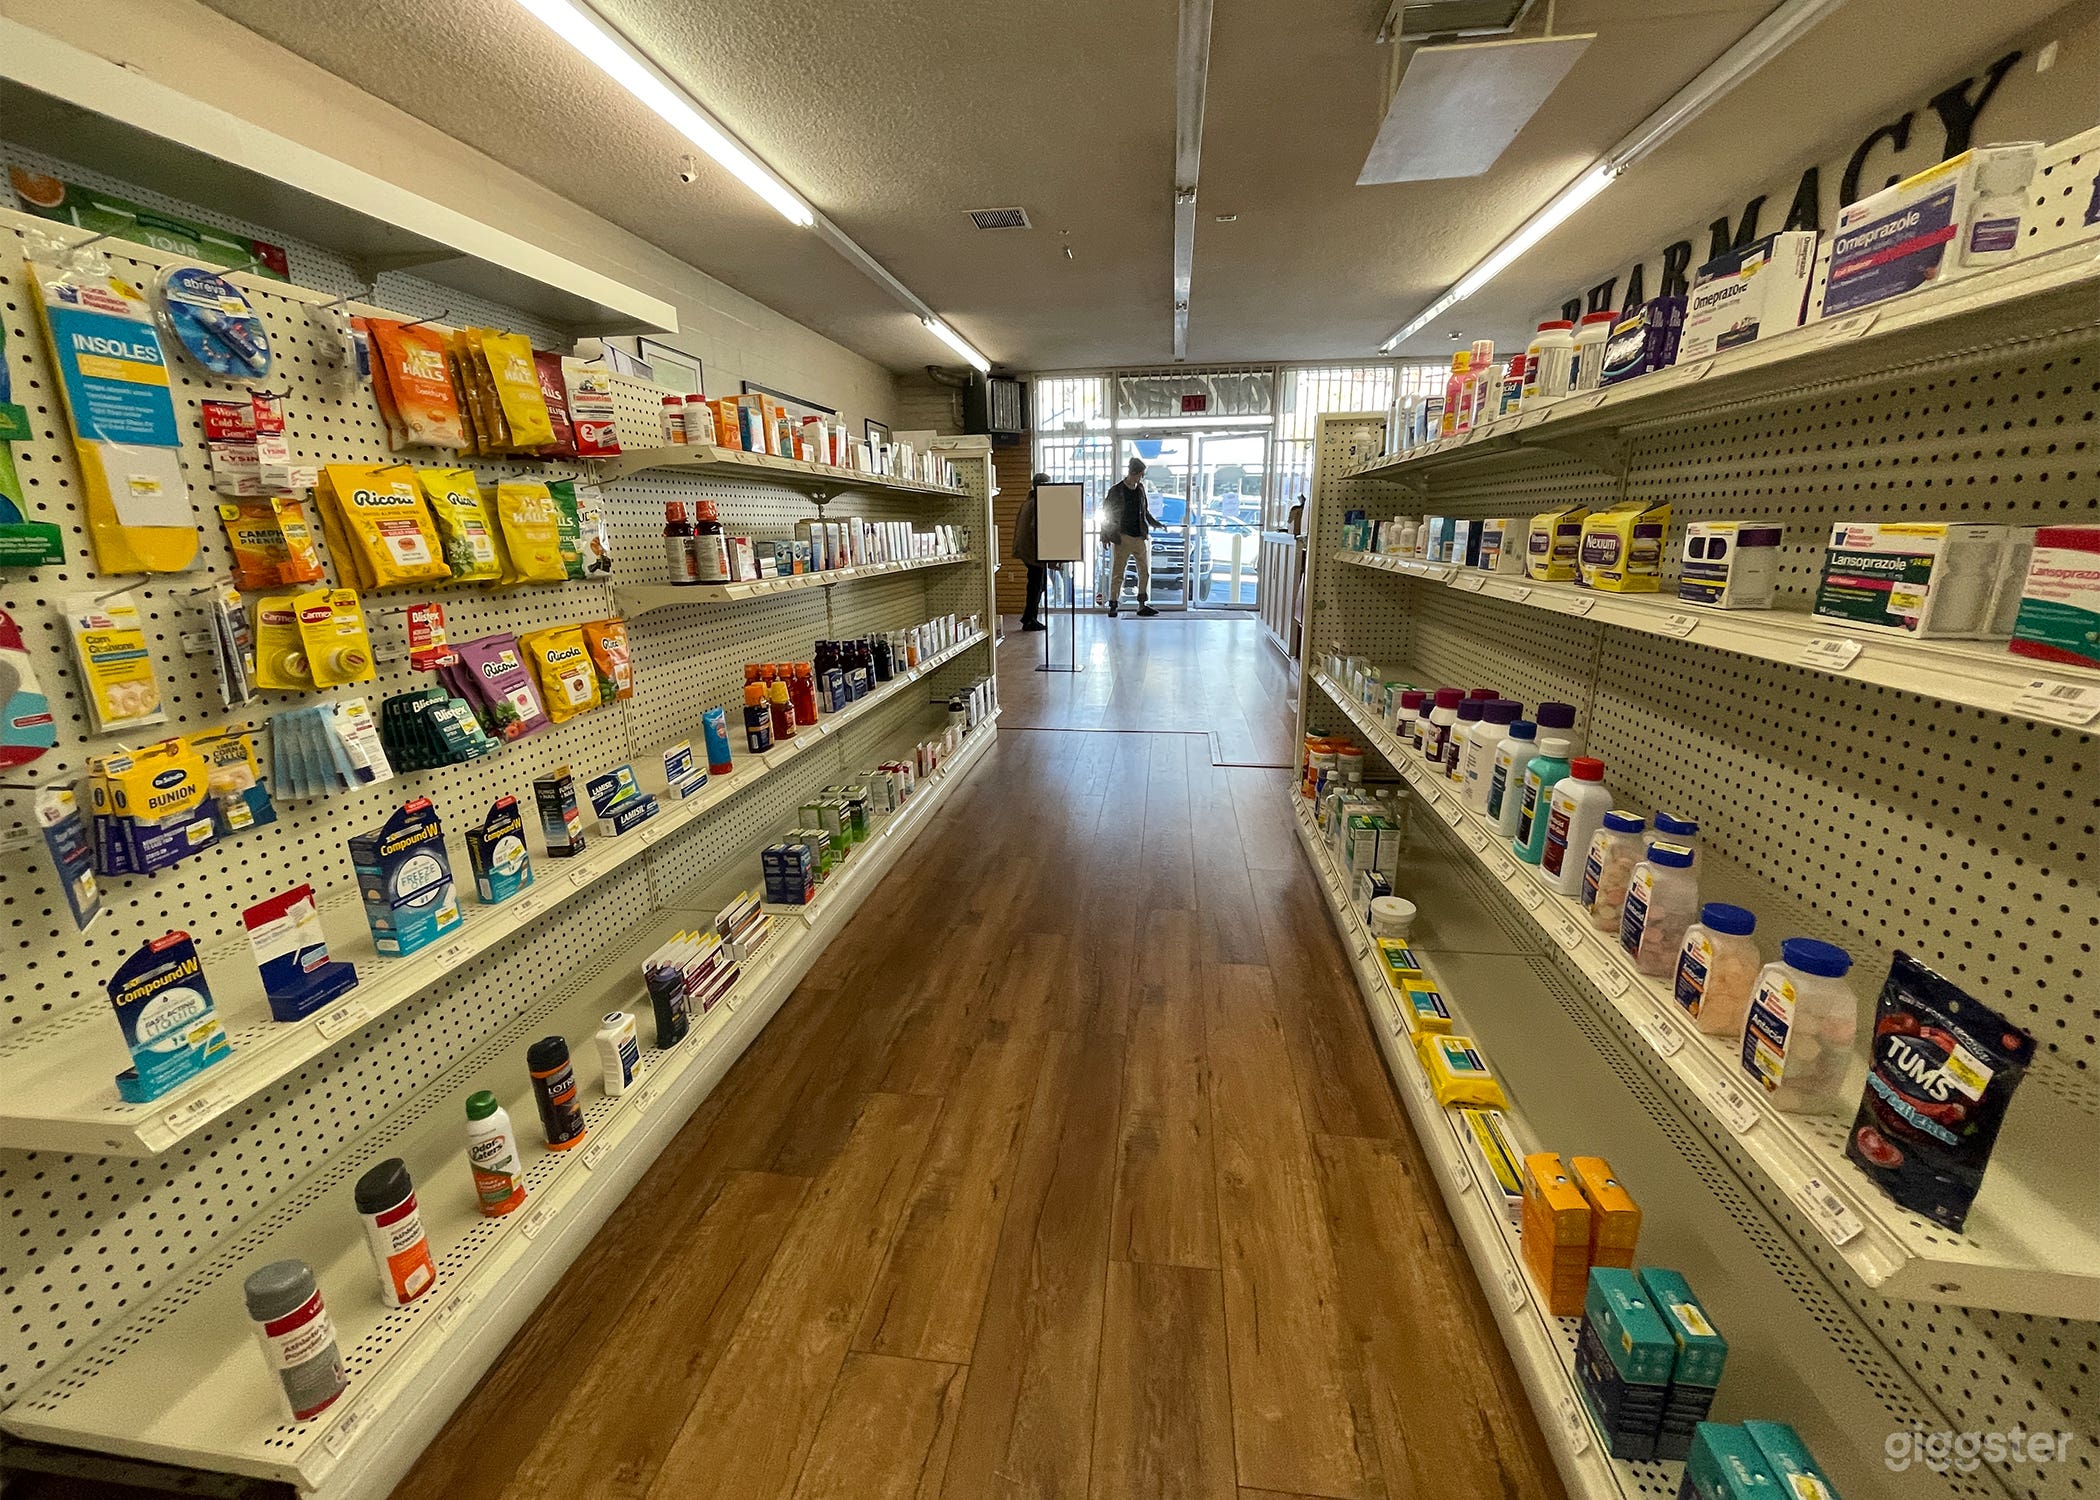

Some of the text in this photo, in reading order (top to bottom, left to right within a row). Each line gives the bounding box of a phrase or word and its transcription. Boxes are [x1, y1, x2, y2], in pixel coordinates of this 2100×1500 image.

[1561, 50, 2023, 324] PHARMACY
[1836, 209, 1920, 255] Omeprazole
[143, 232, 199, 257] YOUR
[183, 276, 227, 297] abreva
[72, 333, 158, 362] INSOLES
[540, 386, 562, 400] ALLS
[585, 427, 593, 435] 2
[238, 530, 284, 538] CAMPH
[1586, 534, 1616, 550] Nexium
[1832, 552, 1906, 570] Lansoprazole
[2031, 565, 2100, 580] Lansoprazo
[300, 610, 332, 621] Carmex
[412, 611, 440, 623] Blistex
[86, 636, 110, 644] Corn
[548, 648, 581, 662] Ricola
[434, 706, 467, 722] Blistex
[148, 783, 197, 809] BUNION
[591, 780, 614, 796] LAMISIL
[620, 804, 646, 824] LAMISIL
[401, 863, 437, 887] FREEZE
[1751, 1013, 1783, 1045] Antacid
[1886, 1034, 1955, 1102] TUMS
